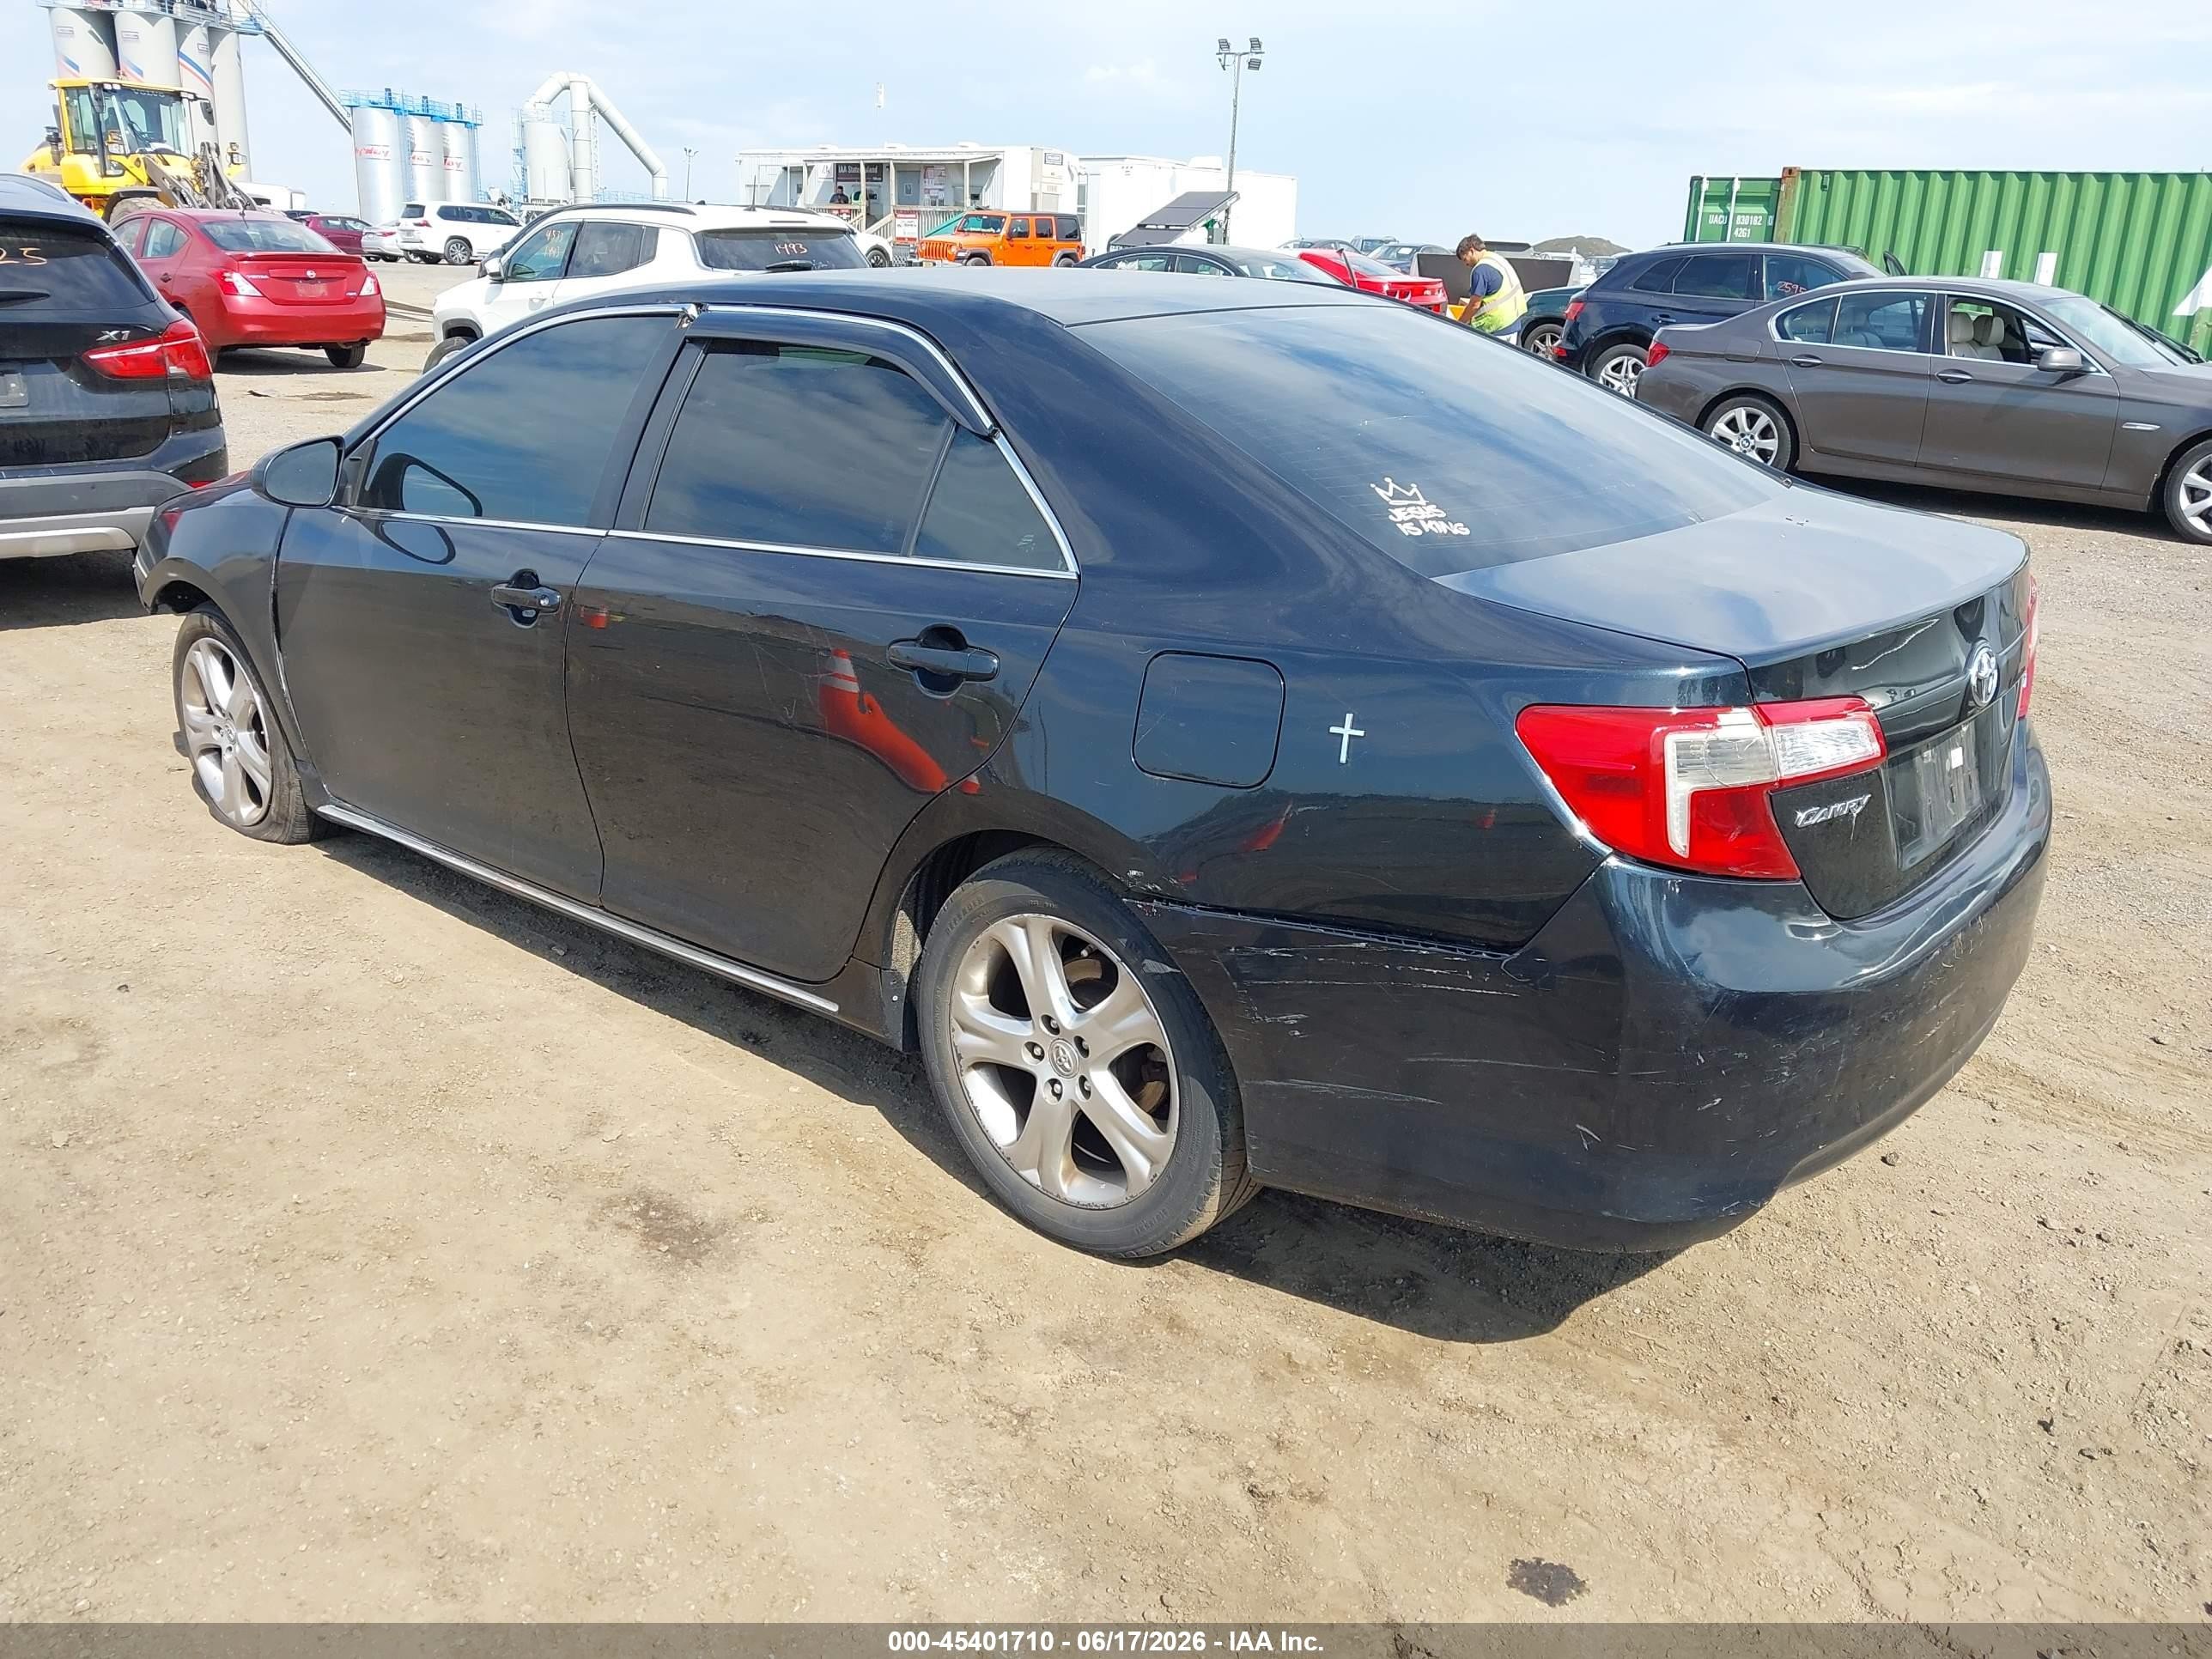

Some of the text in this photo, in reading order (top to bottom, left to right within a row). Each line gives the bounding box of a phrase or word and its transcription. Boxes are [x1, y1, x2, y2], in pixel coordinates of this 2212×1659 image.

[1709, 214, 1728, 225] UACU
[1734, 227, 1751, 238] 42G1
[775, 243, 808, 255] 1493
[96, 330, 131, 342] X1
[1388, 504, 1447, 522] JESUS
[1395, 520, 1471, 536] IS KING
[1794, 793, 1872, 829] CAMRY
